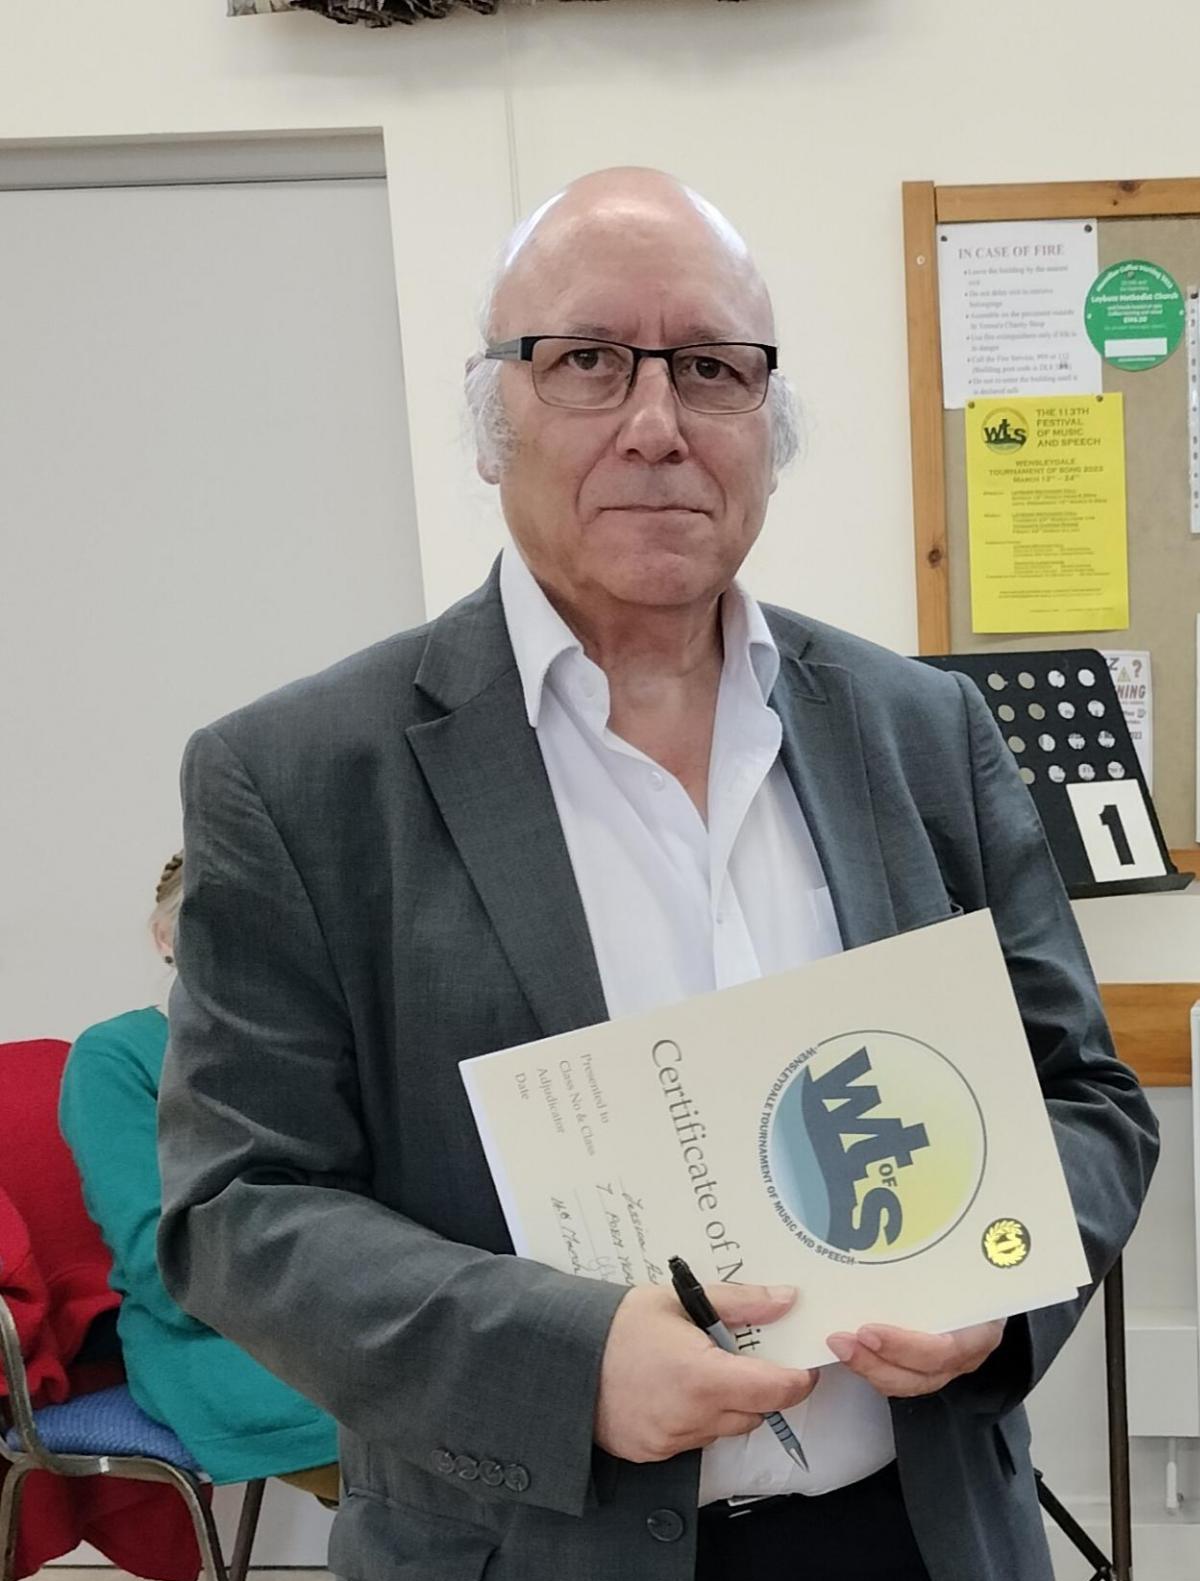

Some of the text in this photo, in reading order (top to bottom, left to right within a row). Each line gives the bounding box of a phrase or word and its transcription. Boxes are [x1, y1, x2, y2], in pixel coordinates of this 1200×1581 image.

[958, 244, 1065, 260] IN CASE OF FIRE
[1154, 292, 1179, 300] Church
[1036, 408, 1057, 417] THE
[1036, 418, 1084, 427] FESTIVAL
[1037, 428, 1084, 438] OF MUSIC
[1037, 437, 1101, 448] AND SPEECH
[1015, 458, 1076, 467] WENSLEYDALE
[1098, 804, 1136, 866] 1
[515, 1072, 529, 1101] Date
[580, 1053, 609, 1124] Presented to
[537, 1067, 564, 1134] Adjudicator
[559, 1060, 595, 1156] Class No & Class
[758, 1047, 855, 1266] WENSLEYDALE TOURNAMENT OF MUSIC AND SPEECH
[878, 1163, 898, 1188] OF
[651, 1038, 763, 1352] Certificate of Mit
